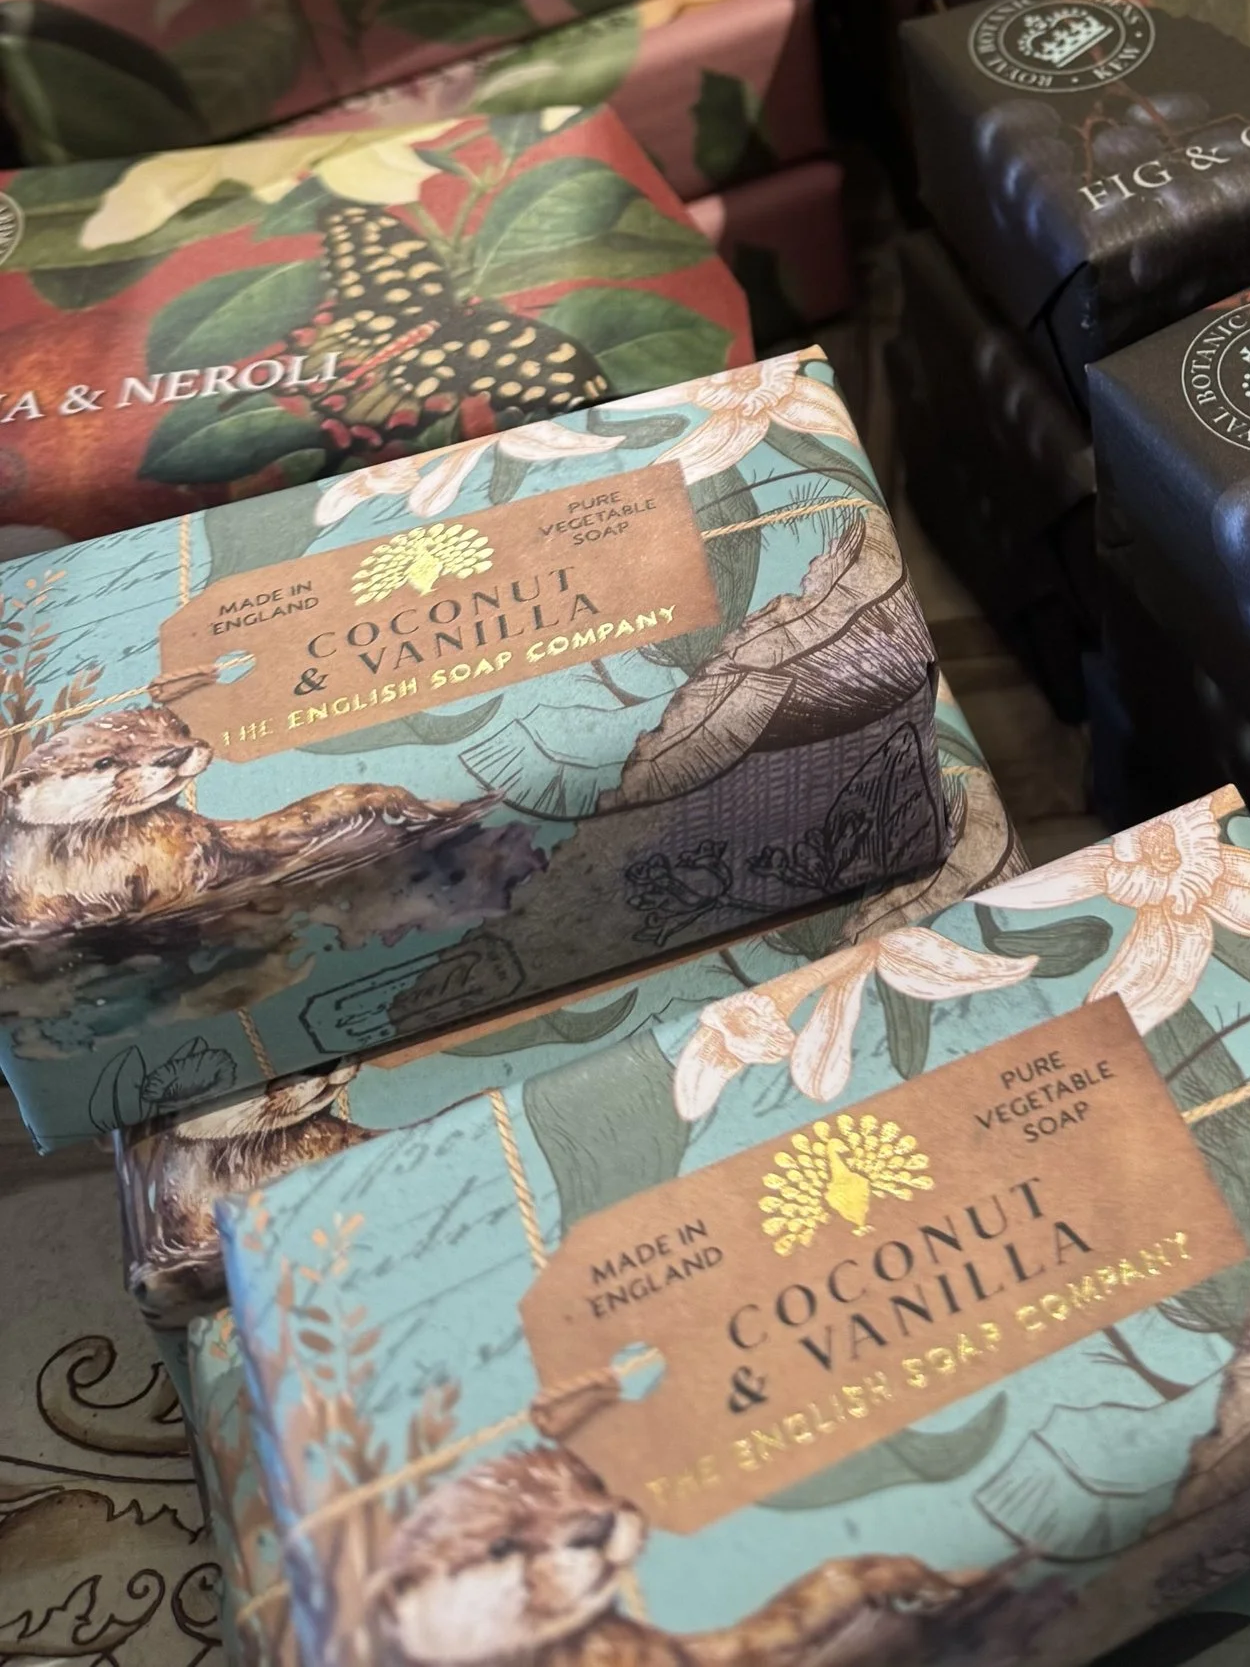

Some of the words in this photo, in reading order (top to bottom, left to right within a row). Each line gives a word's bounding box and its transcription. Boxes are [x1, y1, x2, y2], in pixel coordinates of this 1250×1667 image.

[984, 54, 1053, 88] ROYAL
[1092, 41, 1141, 80] KEW
[1078, 160, 1174, 213] FIG
[1185, 145, 1231, 171] &
[0, 391, 46, 424] A
[58, 384, 106, 416] &
[115, 351, 344, 409] NEROLI
[1190, 314, 1248, 406] BOTANIC
[539, 497, 658, 539] VEGETABLE
[567, 490, 623, 515] PURE
[572, 521, 631, 547] SOAP
[212, 595, 321, 636] ENGLAND
[218, 587, 286, 617] MADE
[289, 579, 314, 598] IN
[307, 566, 576, 661] COCONUT
[287, 676, 420, 731] ENGLISH
[430, 650, 514, 691] SOAP
[525, 604, 678, 664] COMPANY
[292, 666, 330, 698] &
[358, 592, 602, 677] VANILLA
[974, 1059, 1118, 1131] VEGETABLE
[1000, 1049, 1066, 1090] PURE
[1023, 1099, 1092, 1144] SOAP
[586, 1245, 724, 1319] ENGLAND
[590, 1233, 672, 1285] MADE
[675, 1218, 709, 1246] IN
[728, 1176, 1045, 1352] COCONUT
[726, 1365, 771, 1415] &
[797, 1220, 1096, 1373] VANILLA
[645, 1453, 724, 1510] THE
[733, 1369, 895, 1473] ENGLISH
[901, 1319, 1003, 1390] SOAP
[1014, 1230, 1192, 1332] COMPANY
